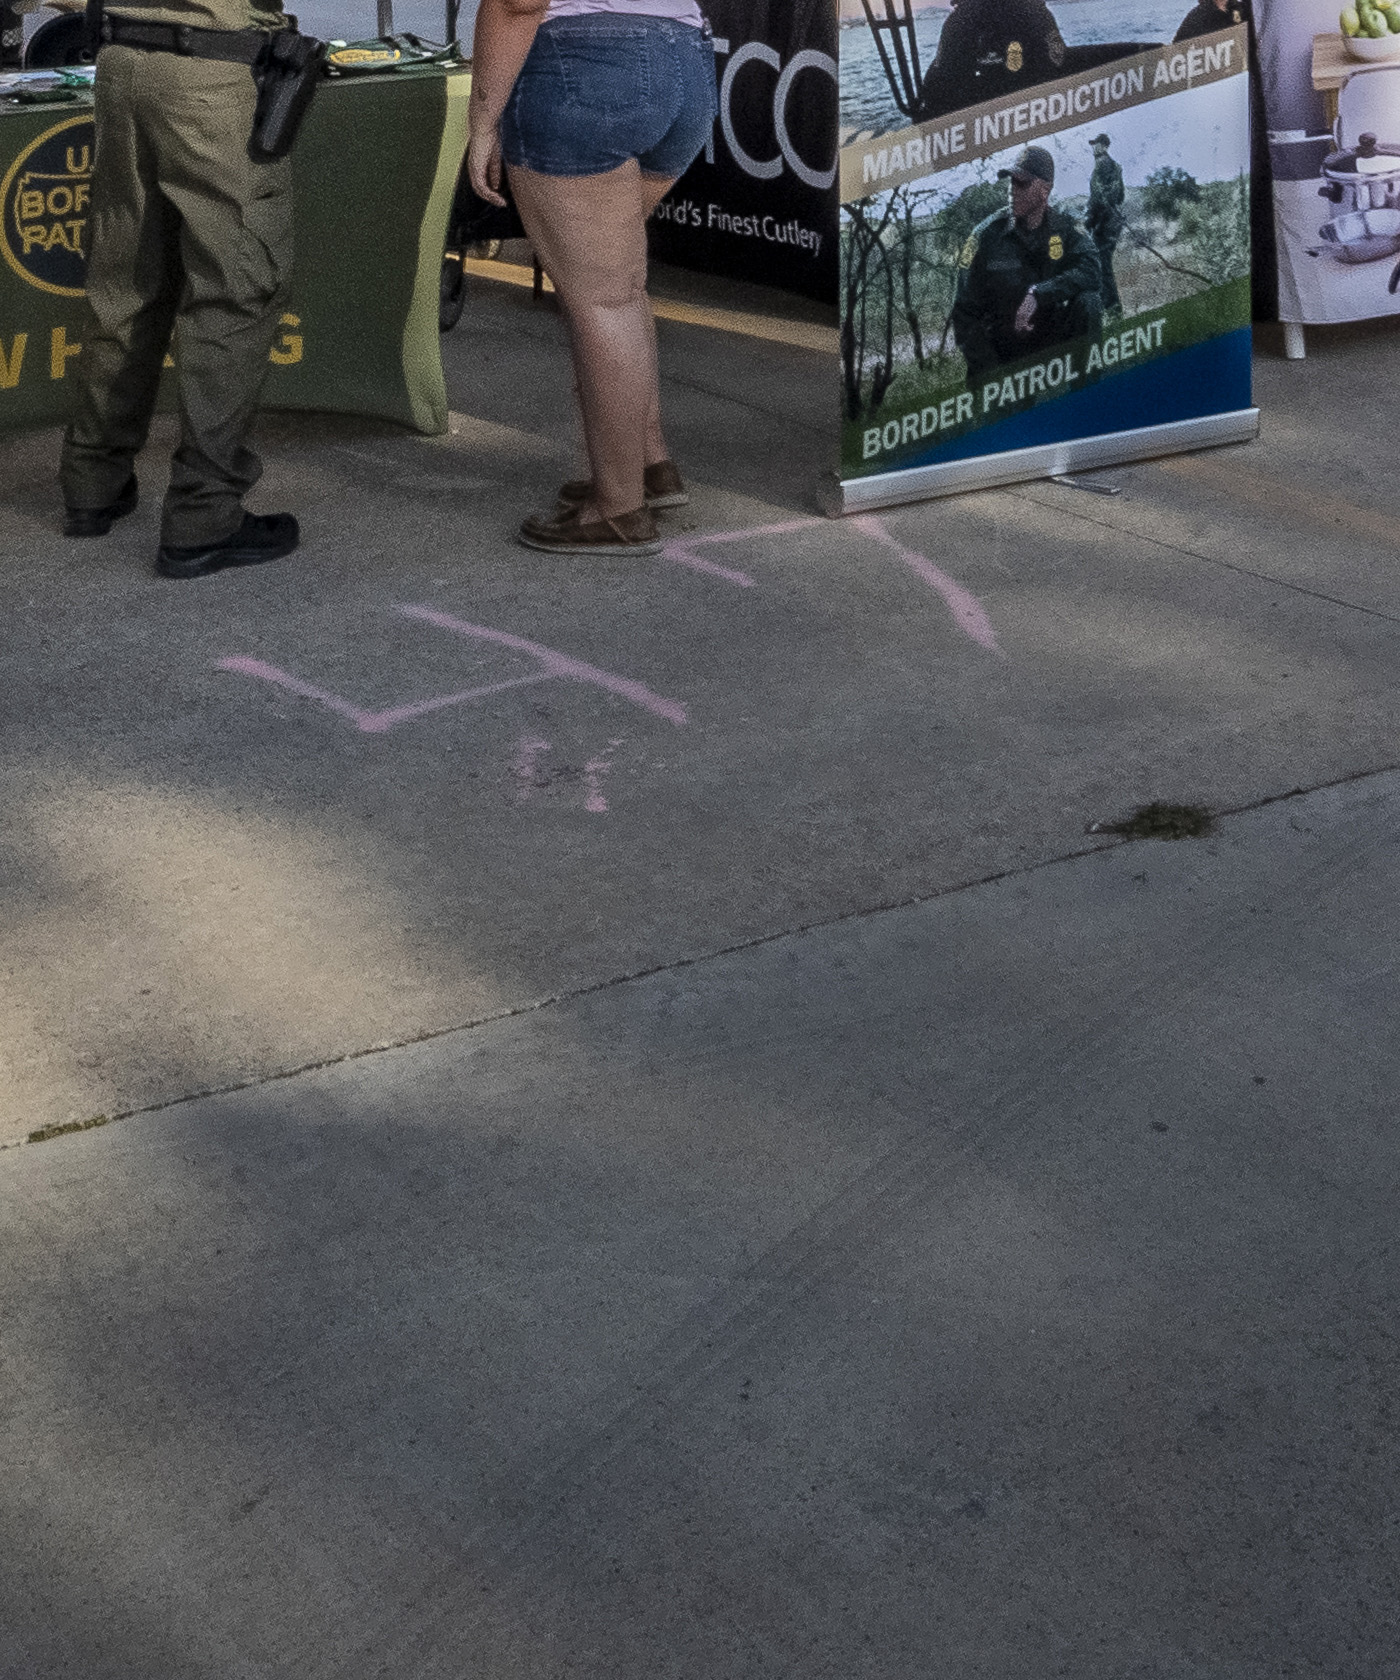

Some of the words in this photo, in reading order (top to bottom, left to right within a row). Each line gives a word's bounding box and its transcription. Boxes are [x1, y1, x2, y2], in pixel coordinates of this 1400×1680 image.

[862, 121, 964, 184] MARINE
[974, 69, 1144, 146] INTERDICTION
[1153, 40, 1235, 87] AGENT
[707, 202, 760, 238] Finest
[762, 215, 823, 258] Cutlery
[862, 392, 973, 459] BORDER
[982, 357, 1077, 412] PATROL
[1087, 319, 1167, 371] AGENT
